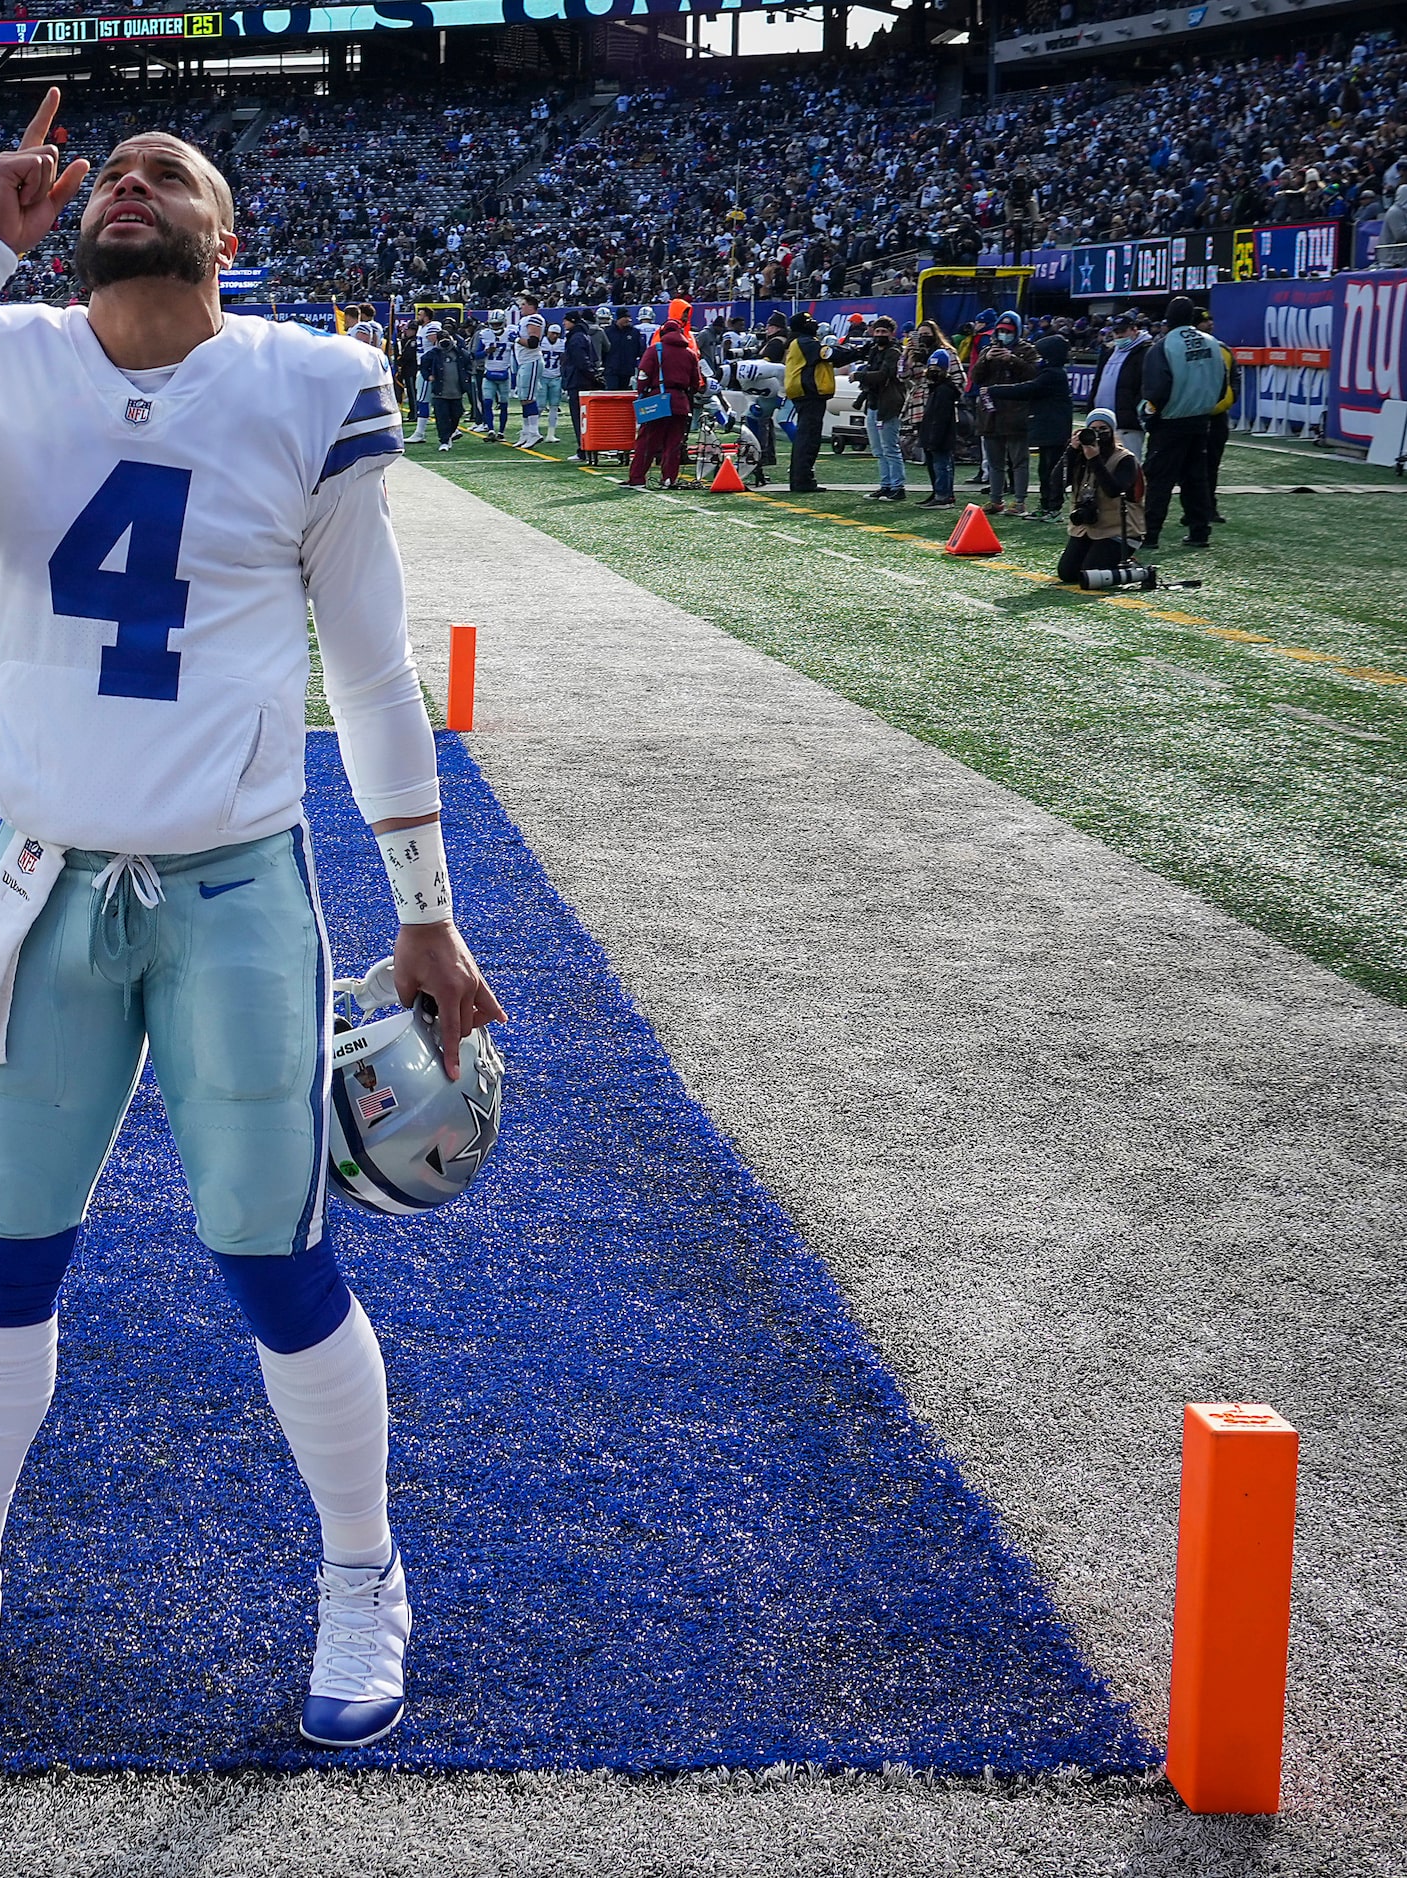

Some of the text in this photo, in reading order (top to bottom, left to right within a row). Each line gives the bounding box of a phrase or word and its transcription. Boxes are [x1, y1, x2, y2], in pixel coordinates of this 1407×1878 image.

[16, 23, 27, 33] TO
[48, 21, 87, 40] 10:11
[99, 17, 183, 36] 1ST QUARTER
[193, 15, 213, 35] 25
[1105, 249, 1116, 292] 0
[1137, 248, 1168, 288] 10:11
[1234, 243, 1254, 282] 25
[128, 407, 146, 421] NFL
[48, 459, 192, 702] 4
[19, 850, 38, 873] NFL
[2, 870, 30, 901] Wilson
